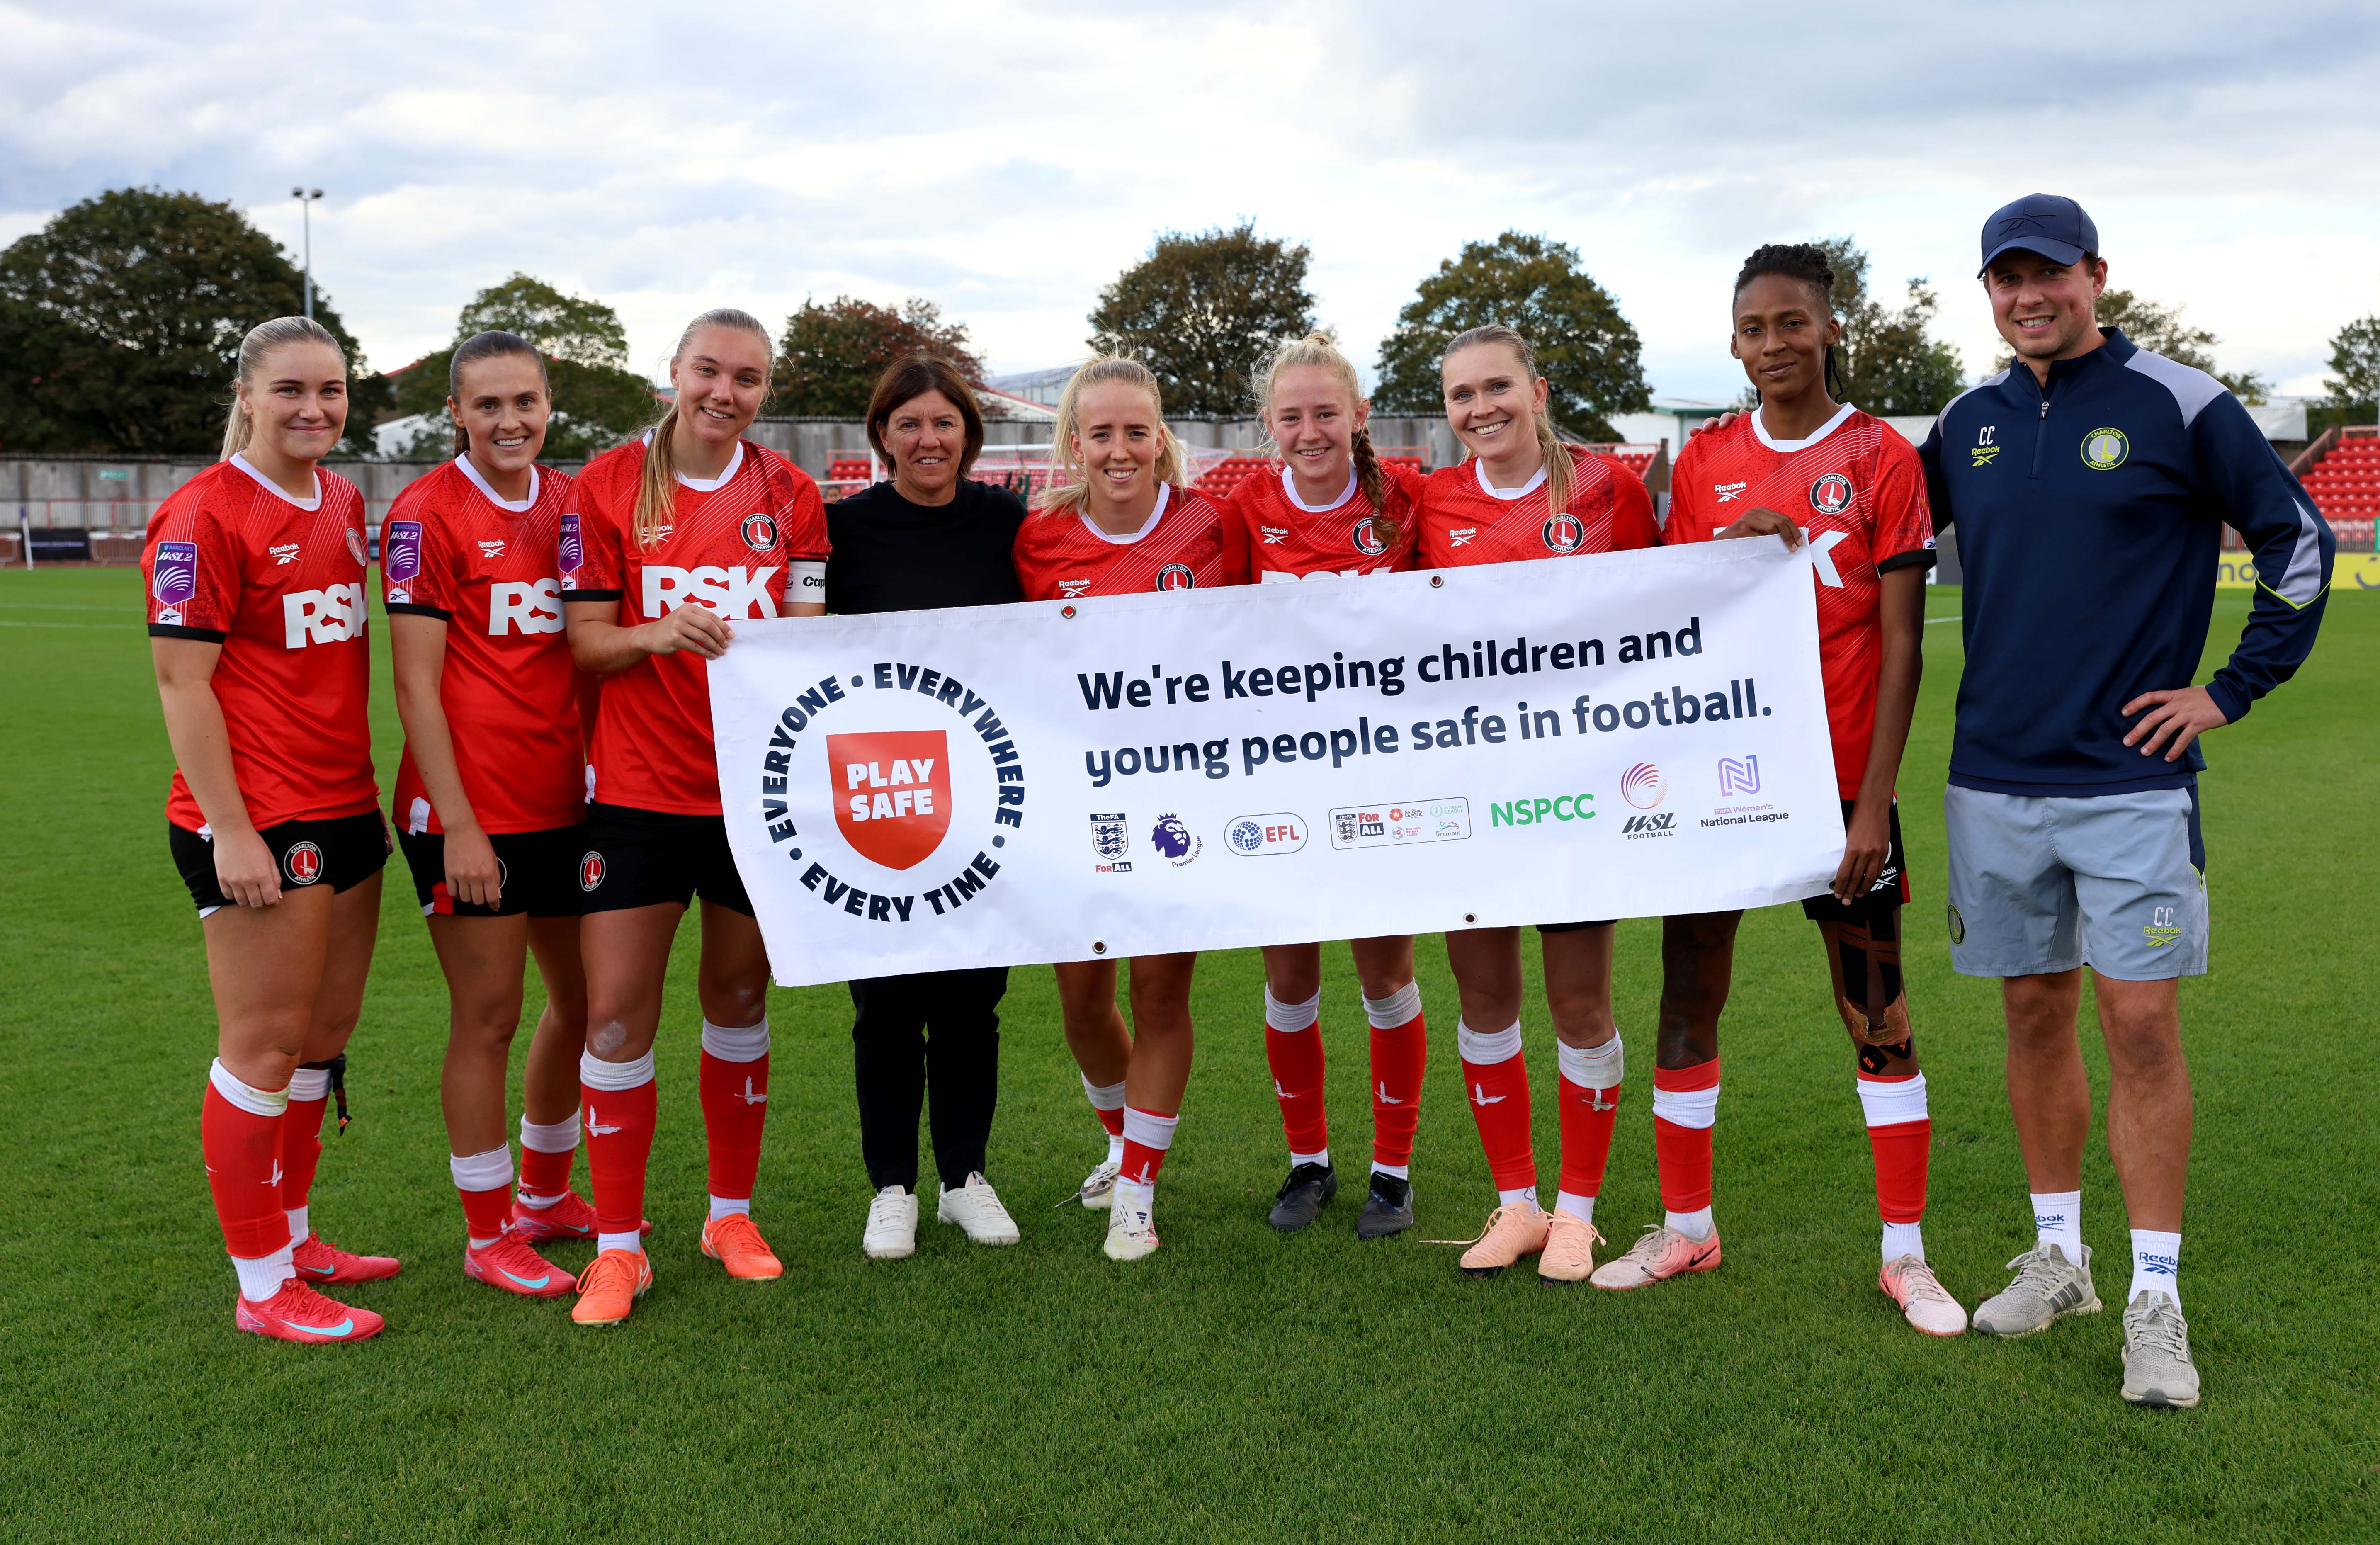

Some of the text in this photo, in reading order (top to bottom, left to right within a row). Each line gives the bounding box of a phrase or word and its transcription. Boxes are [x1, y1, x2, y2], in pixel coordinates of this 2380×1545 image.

[1979, 426, 1995, 446] CC
[2091, 429, 2122, 439] CHARLTON
[1972, 446, 2000, 456] Reebok
[2090, 460, 2115, 468] ATHLETIC
[1820, 475, 1847, 485] CHARLTON
[1715, 481, 1746, 493] Reebok
[746, 515, 771, 524] CHARLTON
[1358, 519, 1373, 529] CHARL
[1550, 515, 1577, 525] CARLTON
[1261, 526, 1289, 535] Reebok
[1449, 527, 1477, 538] Reebok
[269, 543, 299, 554] Reebok
[158, 552, 193, 562] WSL2
[1162, 565, 1188, 574] CHARLTON
[1059, 578, 1090, 588] Reebok
[642, 566, 780, 619] RSK
[488, 578, 566, 636] RS
[1077, 617, 1702, 710] We're keeping children and
[1086, 679, 1771, 787] young people safe in football.
[874, 663, 1024, 828] EVERYWHERE
[763, 676, 845, 843] EVERYONE
[846, 758, 935, 790] PLAY
[850, 788, 933, 821] SAFE
[1733, 804, 1773, 813] Women's
[1491, 794, 1596, 827] NSPCC
[1358, 813, 1379, 823] FOR
[1622, 813, 1678, 833] WSL
[1701, 812, 1789, 827] National League
[1265, 825, 1299, 842] EFL
[1362, 824, 1383, 835] ALL
[1627, 831, 1673, 840] FOOTBALL
[291, 844, 317, 854] CHARLTON
[1172, 836, 1203, 867] Premier League
[584, 854, 600, 864] CHARLTON
[294, 874, 316, 882] ATHLETIC
[800, 851, 1000, 922] EVERY TIME
[2154, 907, 2173, 926] CC
[2143, 926, 2181, 935] Reebok
